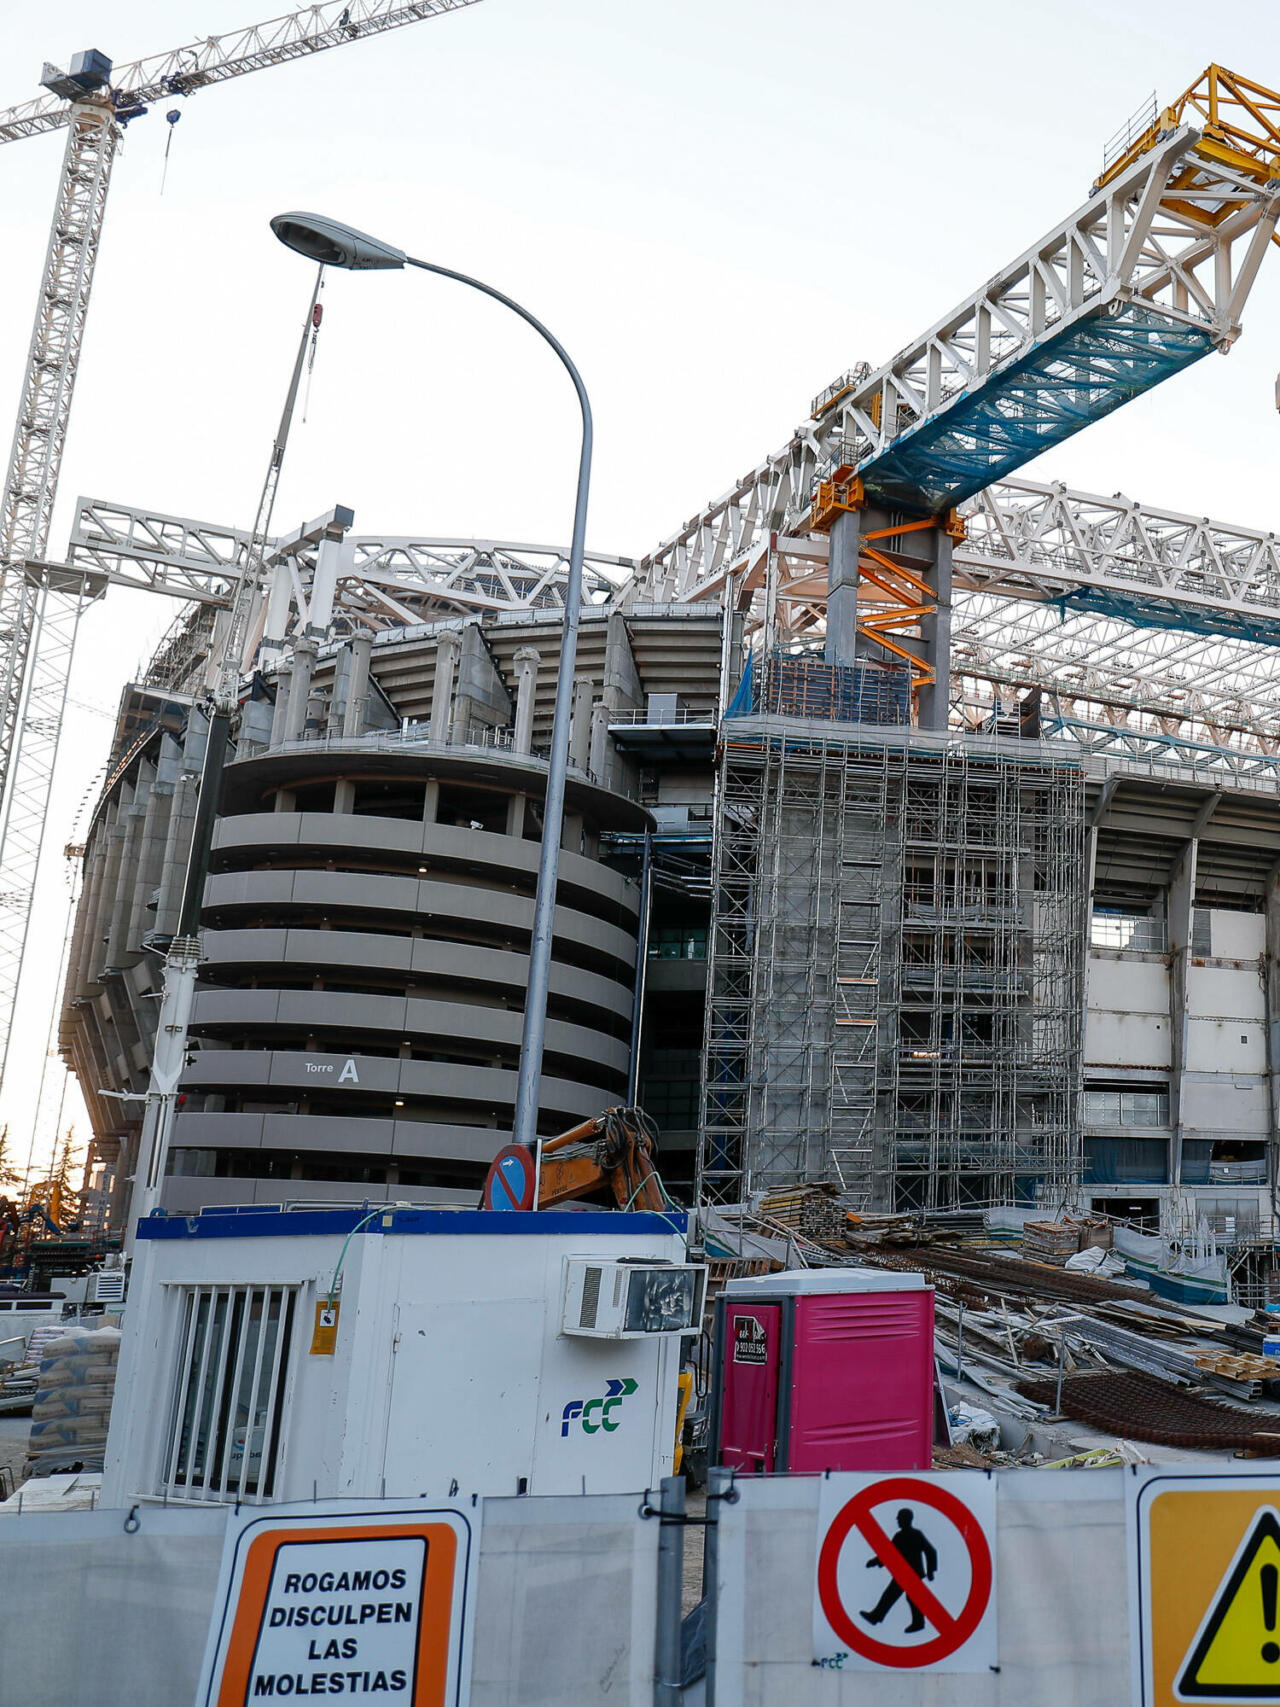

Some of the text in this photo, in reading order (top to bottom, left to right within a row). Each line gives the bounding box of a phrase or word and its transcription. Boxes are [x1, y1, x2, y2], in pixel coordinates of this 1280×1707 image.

[305, 1059, 360, 1083] Torre A
[561, 1396, 623, 1437] FCC
[284, 1569, 407, 1594] ROGAMOS
[269, 1602, 413, 1628] DISCULPEN
[308, 1638, 358, 1660] LAS
[821, 1657, 843, 1669] FCC
[254, 1669, 407, 1696] MOLESTIAS
